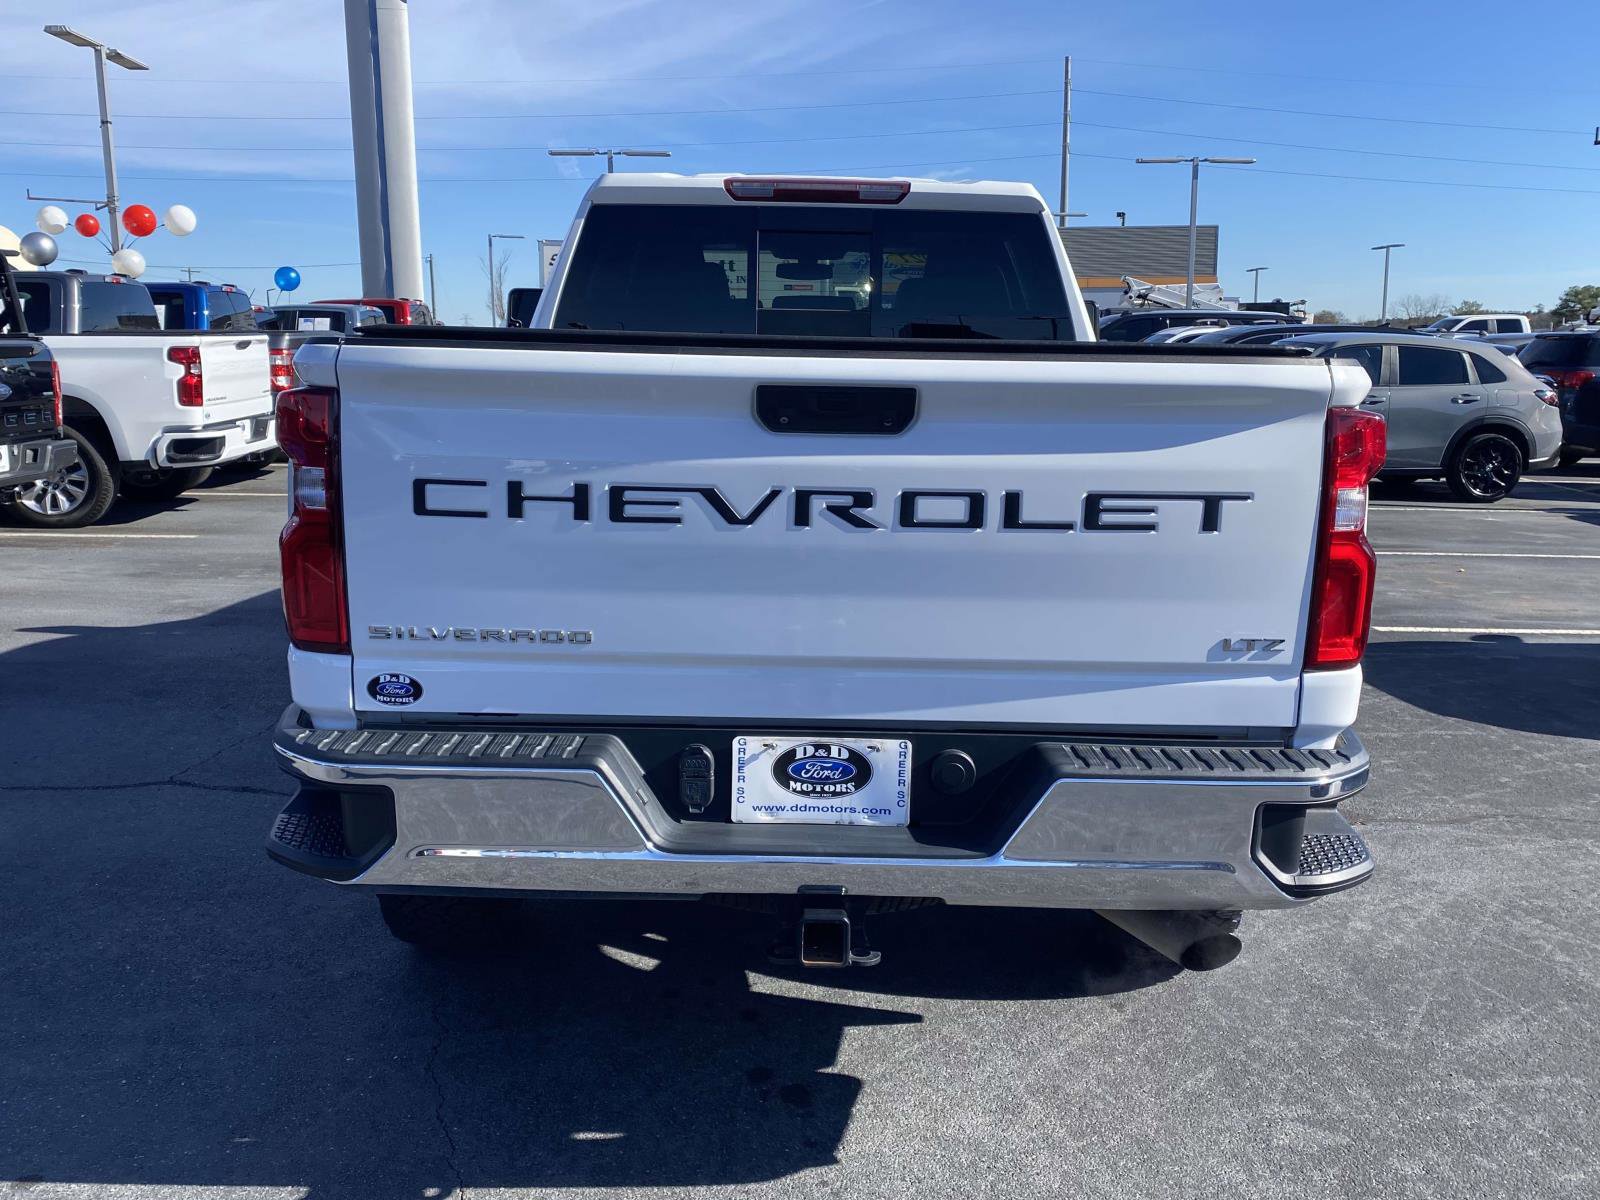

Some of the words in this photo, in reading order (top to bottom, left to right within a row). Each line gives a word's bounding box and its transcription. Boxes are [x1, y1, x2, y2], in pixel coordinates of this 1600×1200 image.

[412, 478, 1254, 533] CHEVROLET
[368, 625, 593, 645] SILVERADO
[1222, 638, 1286, 652] LTZ
[379, 674, 411, 684] D&D
[383, 684, 407, 695] Ford
[376, 695, 414, 704] MOTORS
[737, 738, 747, 783] GREER
[794, 745, 850, 760] D&D
[801, 761, 843, 780] Ford
[898, 741, 908, 787] GREER
[789, 780, 856, 793] MOTORS
[737, 787, 746, 804] SC
[896, 791, 906, 808] SC
[751, 804, 892, 816] www.ddmotors.com
